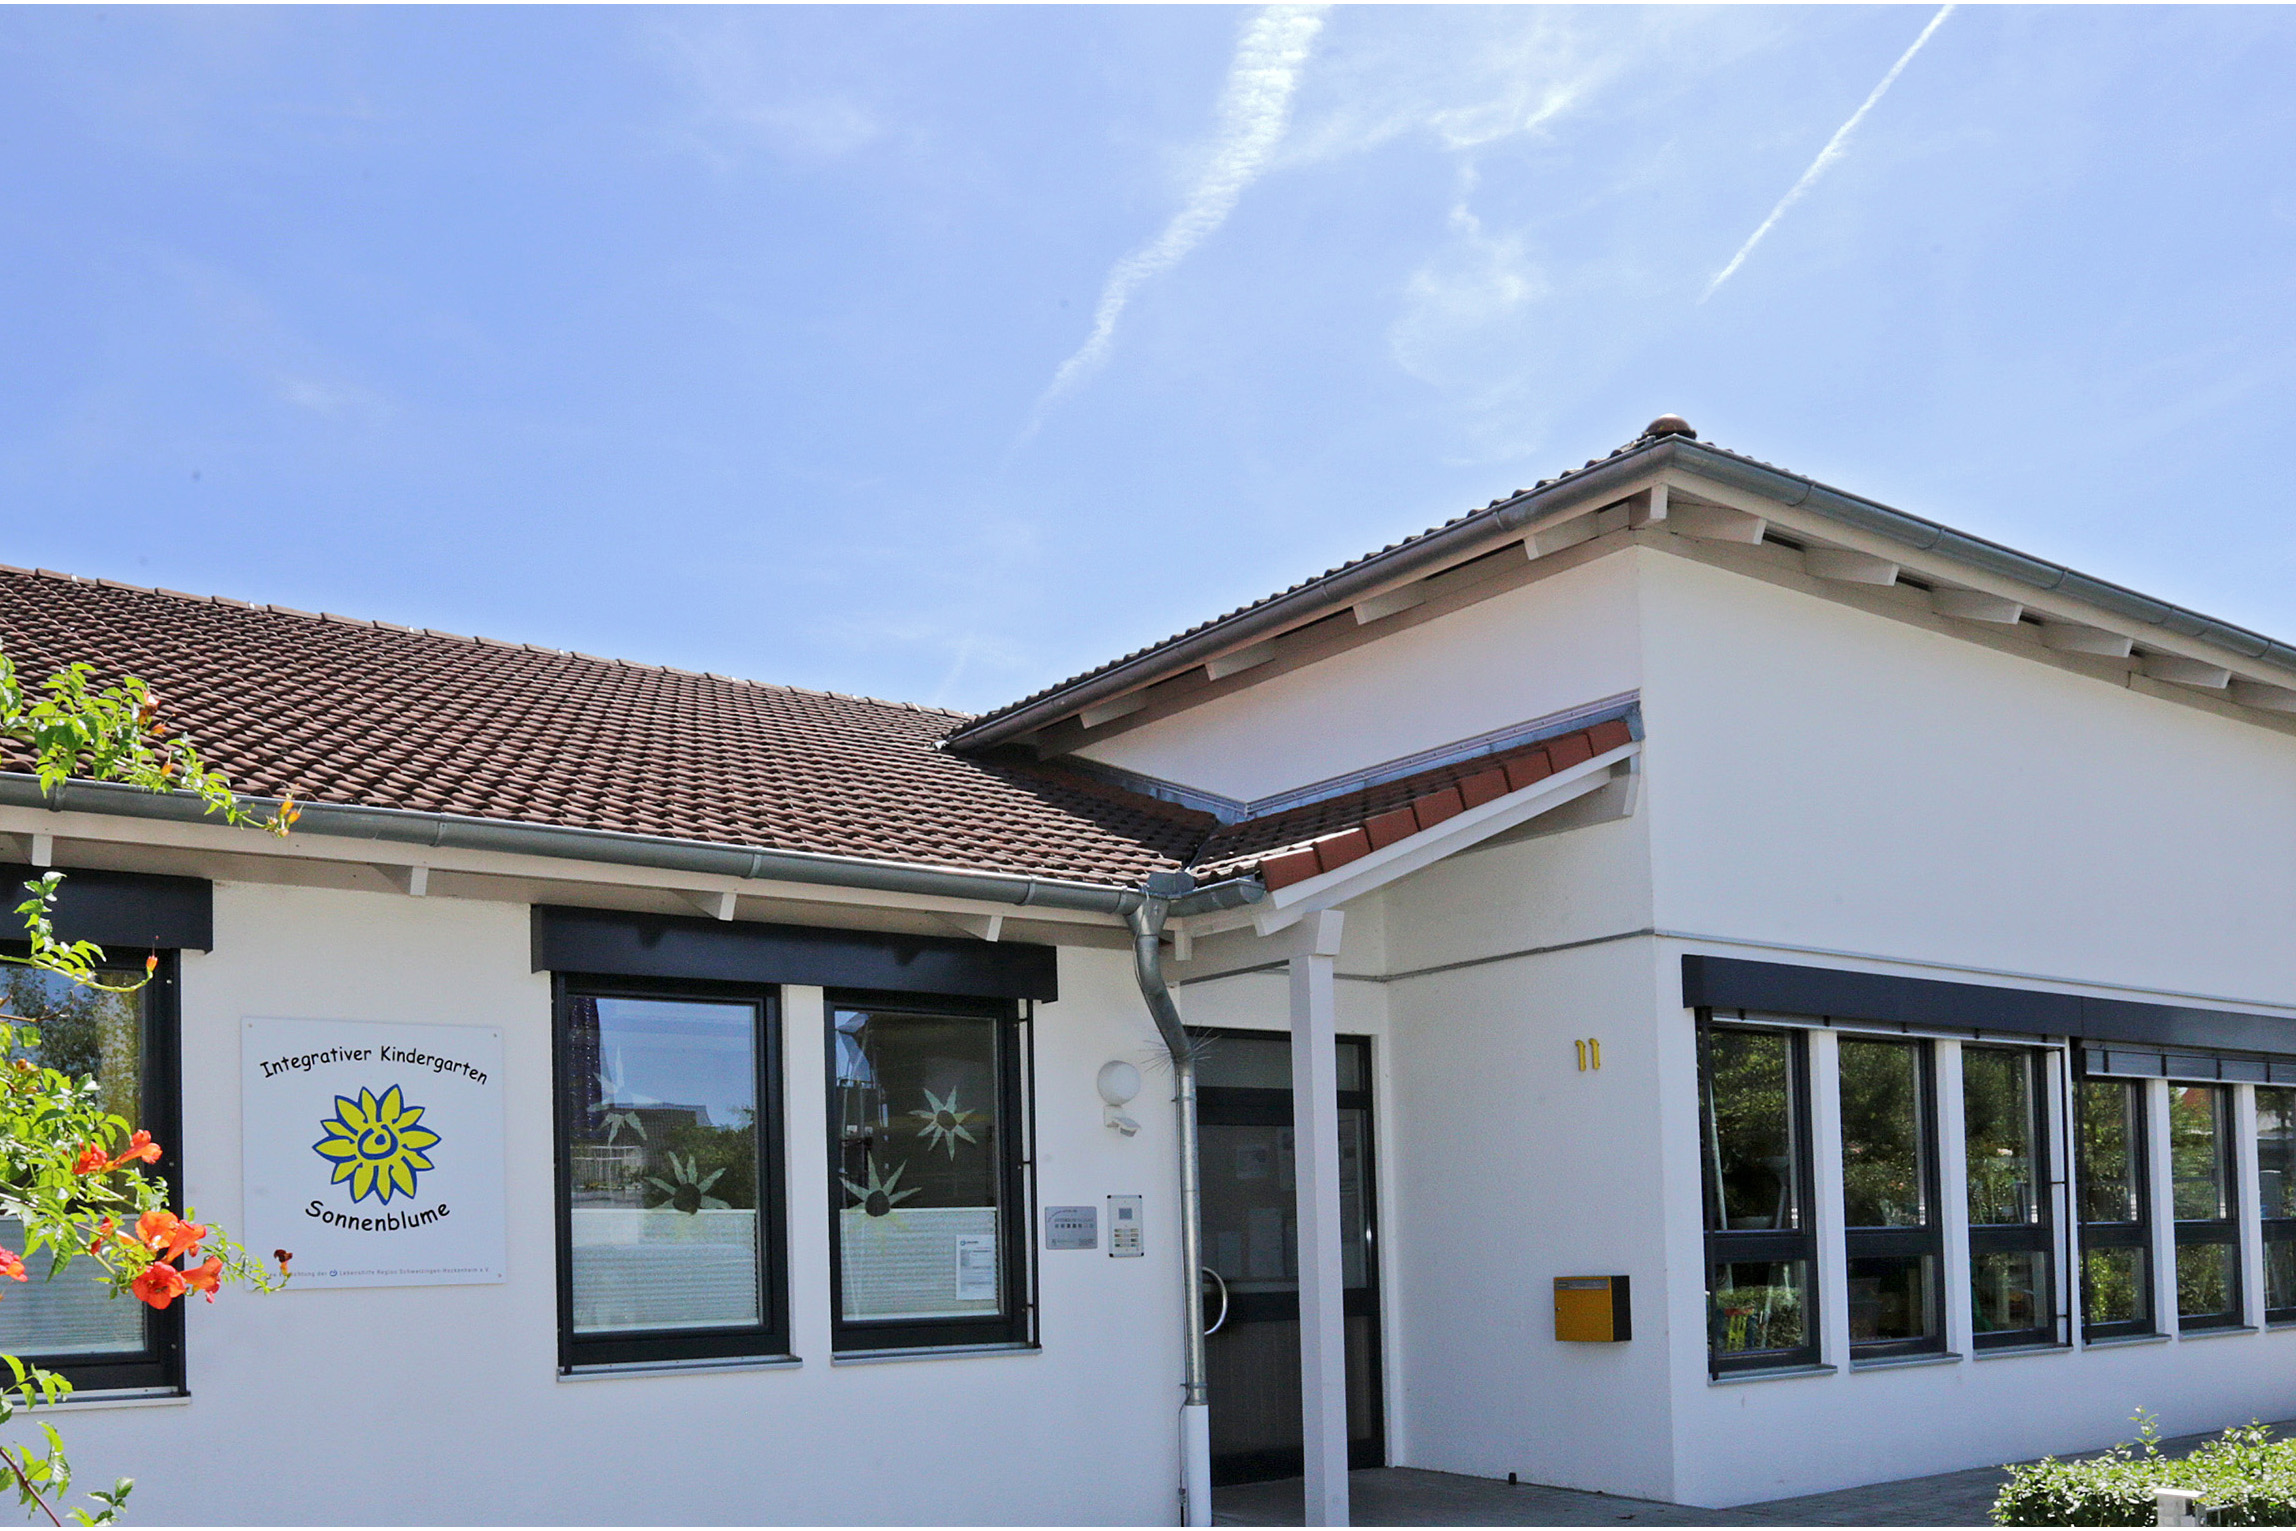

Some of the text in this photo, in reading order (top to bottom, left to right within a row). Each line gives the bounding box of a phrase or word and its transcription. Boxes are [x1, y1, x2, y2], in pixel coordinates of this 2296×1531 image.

[260, 1045, 488, 1085] Integrativer Kindergarten
[1575, 1038, 1600, 1071] 11
[305, 1200, 450, 1232] Sonnenblume
